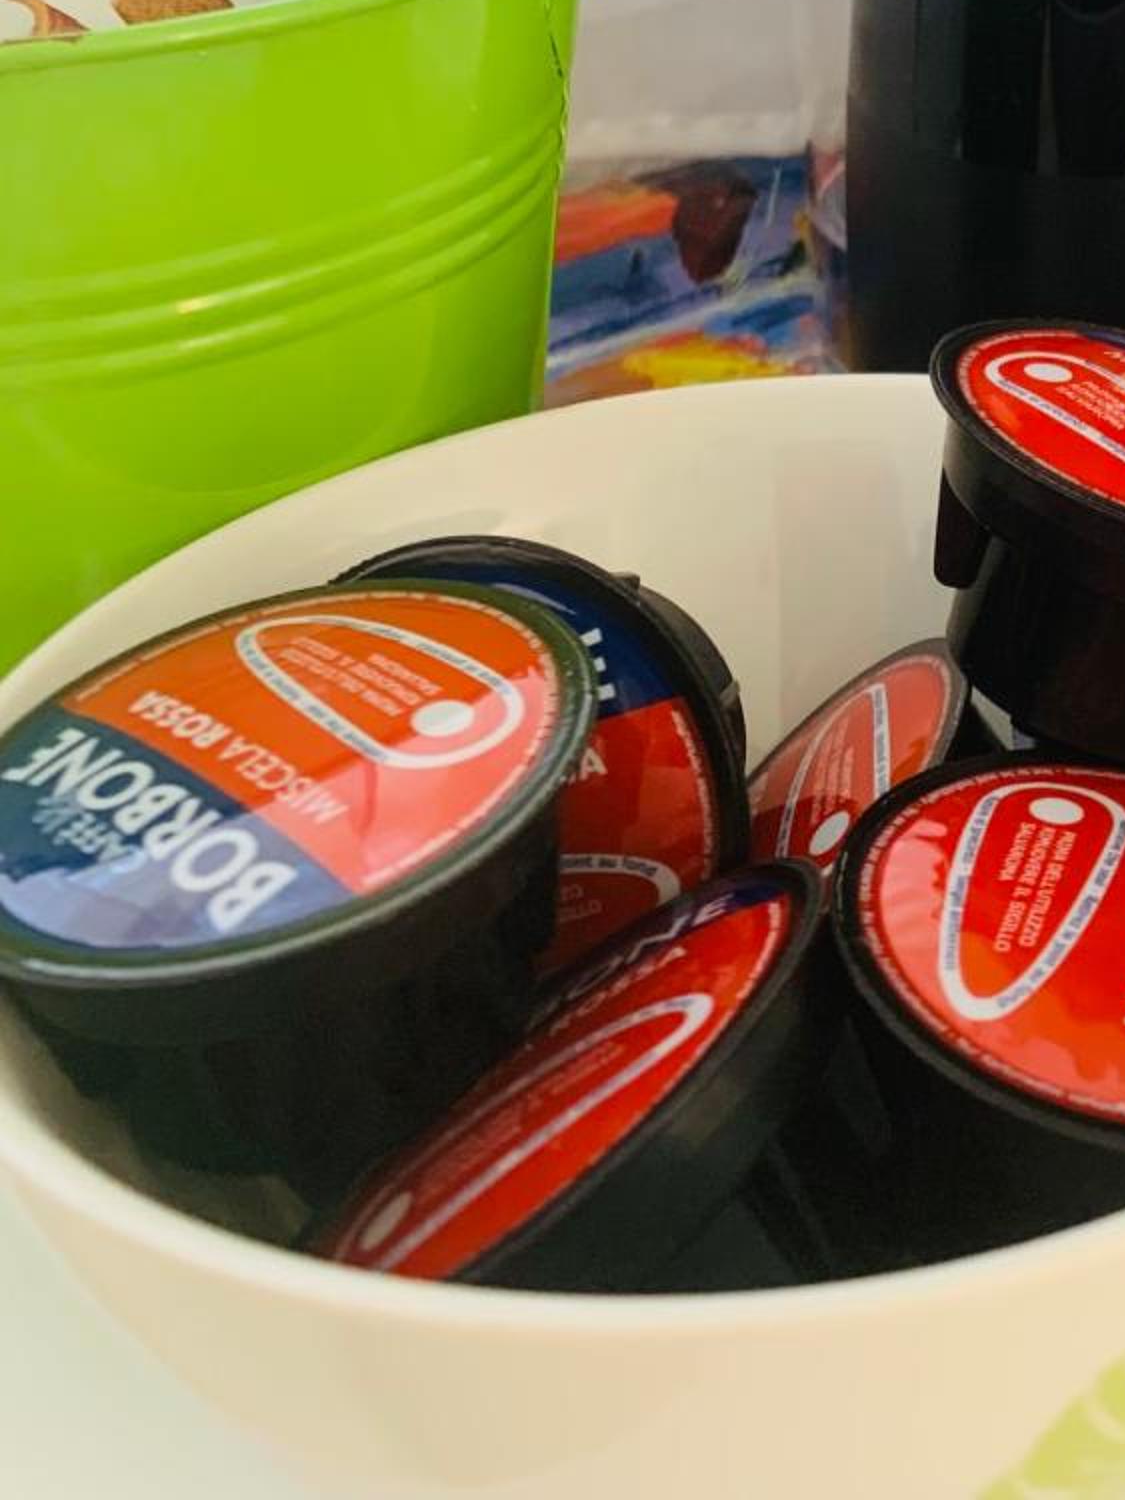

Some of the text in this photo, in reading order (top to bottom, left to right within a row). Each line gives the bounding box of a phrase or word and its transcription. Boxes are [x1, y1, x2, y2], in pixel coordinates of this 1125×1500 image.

[127, 690, 232, 749] ROSSA
[217, 735, 350, 825] MISCELA
[1, 727, 298, 932] BORBONE
